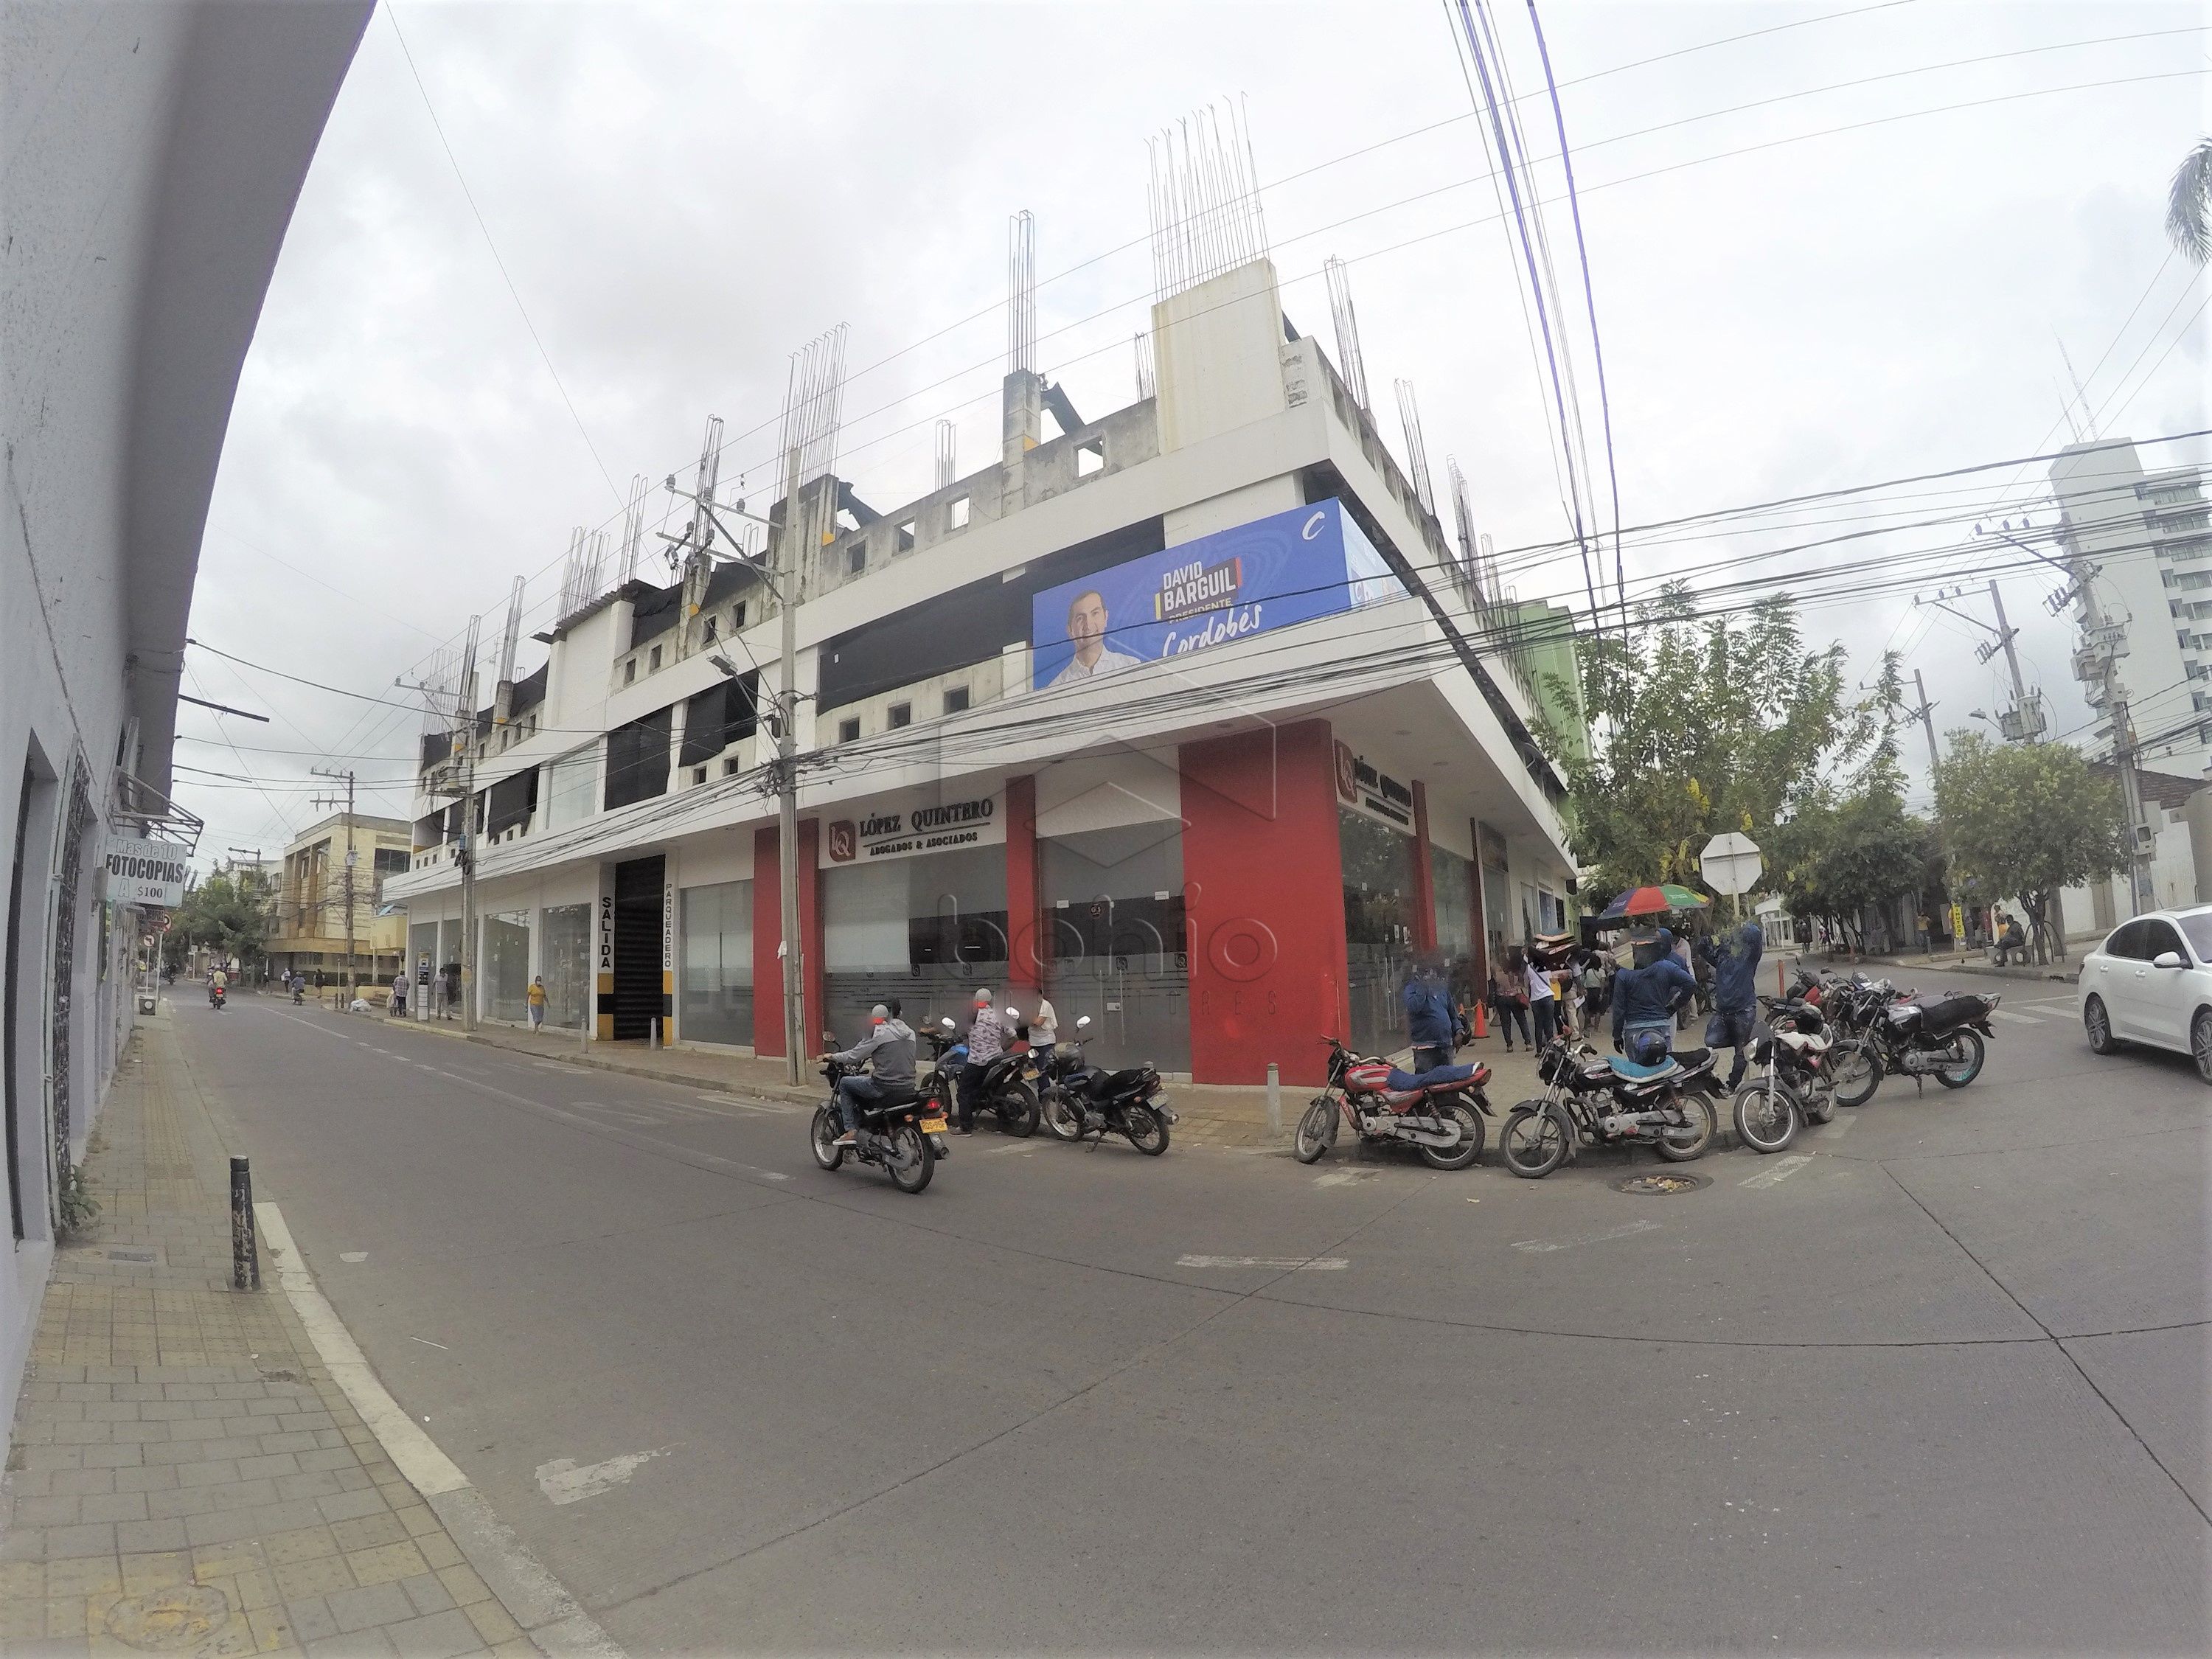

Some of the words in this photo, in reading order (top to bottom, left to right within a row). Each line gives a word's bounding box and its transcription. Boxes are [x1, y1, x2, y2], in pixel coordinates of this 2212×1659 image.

[1163, 560, 1203, 590] DAVID
[1164, 567, 1236, 612] BARGUIL
[860, 813, 901, 838] LÓPEZ
[911, 798, 993, 831] QUINTERO
[116, 839, 142, 856] Mas
[143, 843, 159, 858] de
[161, 844, 178, 860] 10
[869, 841, 913, 856] ABOGADOS
[916, 840, 923, 849] &
[926, 832, 978, 848] ASOCIADOS
[105, 854, 184, 883] FOTOCOPIAS
[118, 878, 130, 897] A
[137, 886, 163, 899] $100
[601, 897, 611, 967] SALIDA
